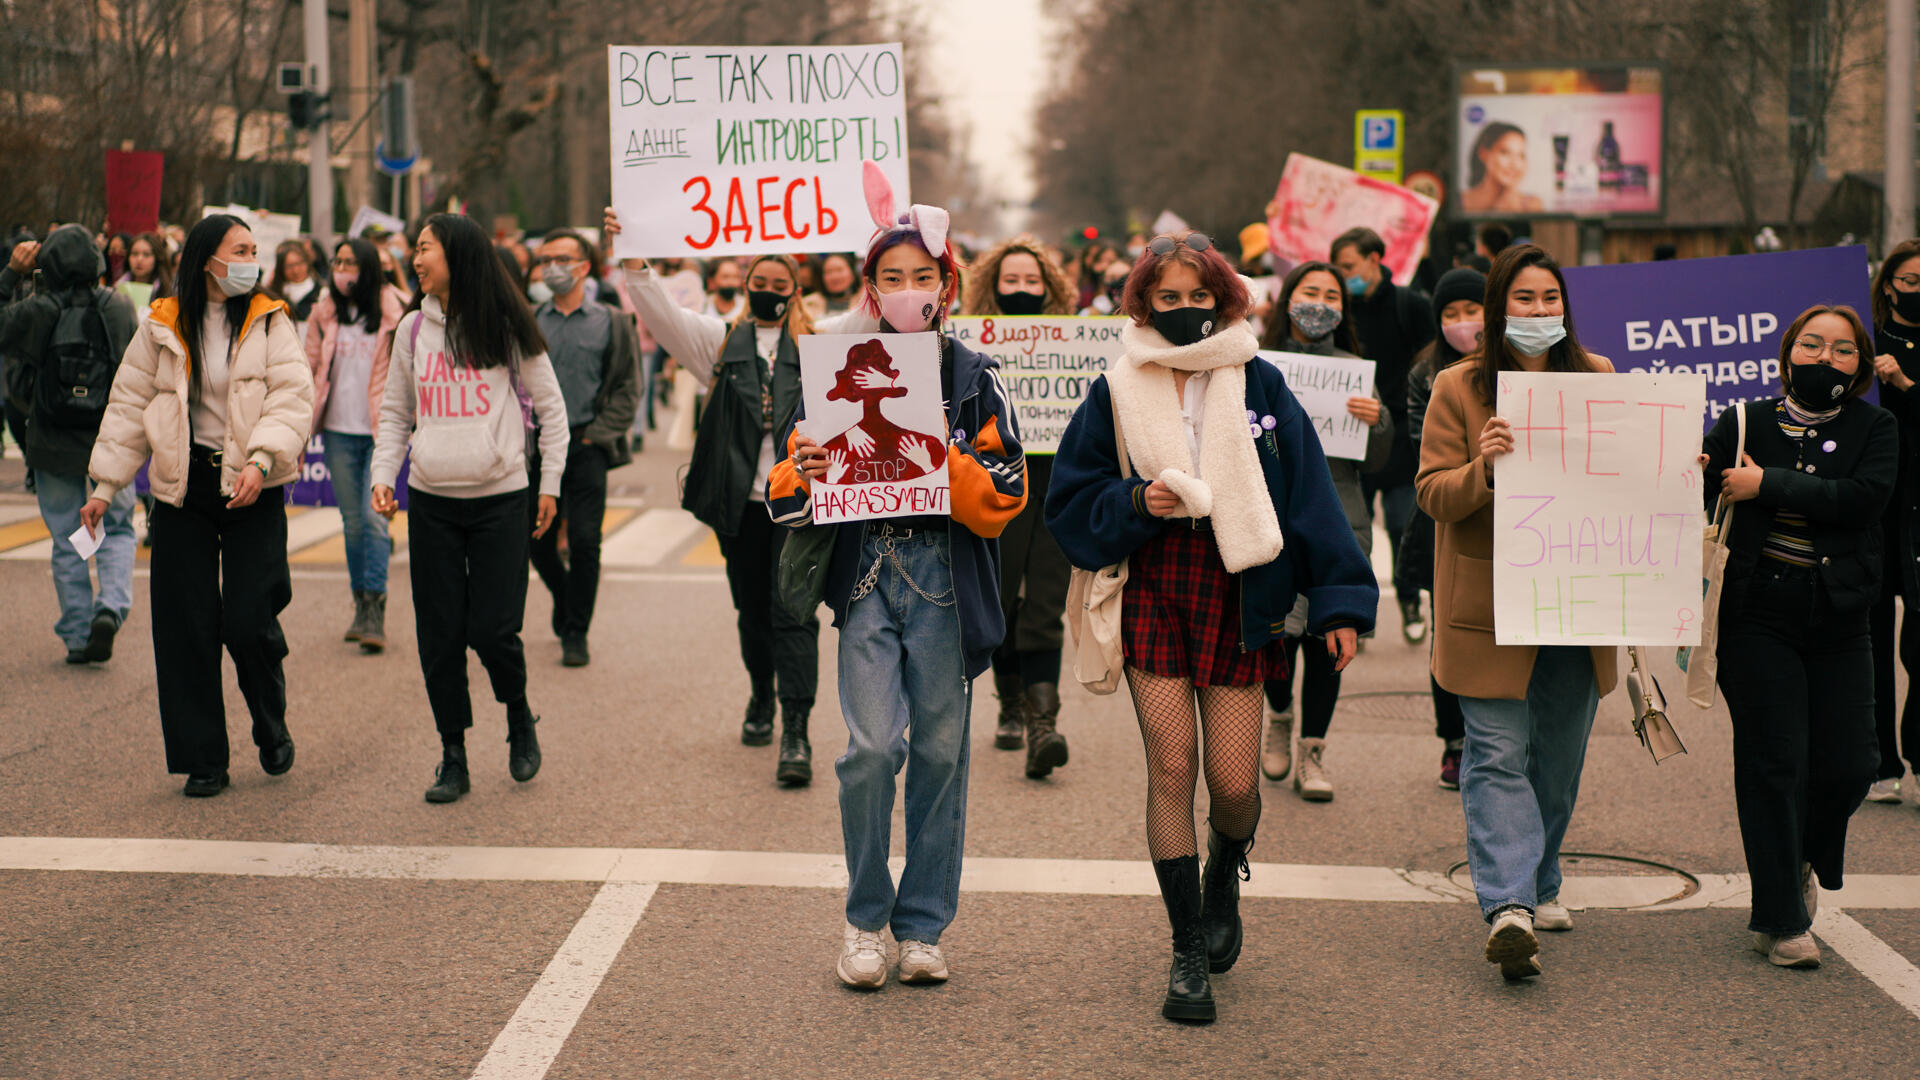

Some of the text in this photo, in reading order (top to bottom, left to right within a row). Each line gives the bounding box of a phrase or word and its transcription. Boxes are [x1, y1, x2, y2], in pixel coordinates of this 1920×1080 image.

[620, 50, 899, 107] ВСЁ ТАК ПЛОХО
[625, 117, 901, 165] ДАЖЕ ИНТРОВЕРТЫ
[1367, 118, 1392, 148] P
[682, 176, 838, 250] ЗДЕСЬ
[980, 318, 996, 345] 8
[997, 324, 1070, 355] марта
[1088, 327, 1123, 344] хоч
[1625, 312, 1778, 351] БАТЫР
[1004, 375, 1050, 401] НОГО
[1275, 360, 1363, 394] НЩИНА
[418, 383, 491, 417] WILLS
[854, 458, 907, 483] STOP
[814, 485, 950, 521] HARASSMENT
